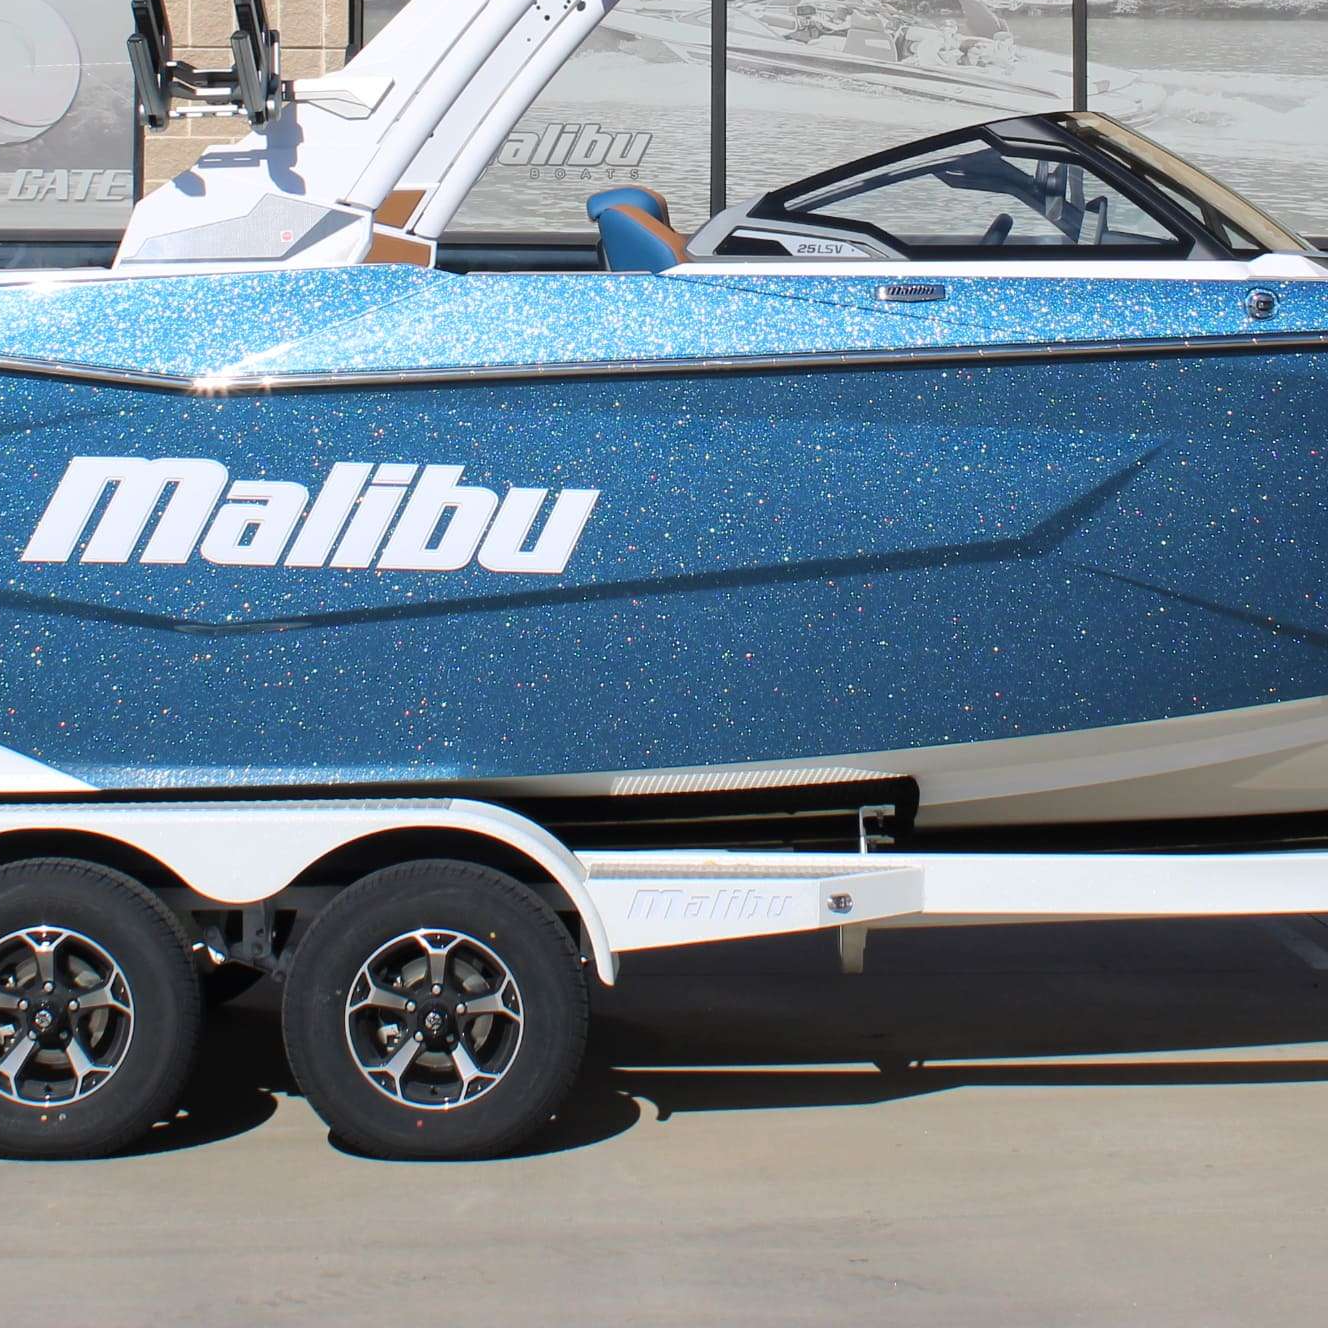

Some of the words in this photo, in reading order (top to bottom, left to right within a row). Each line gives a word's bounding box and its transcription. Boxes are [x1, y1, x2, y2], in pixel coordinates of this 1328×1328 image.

[488, 123, 653, 167] alibu
[8, 168, 133, 202] GATE
[529, 168, 639, 180] BOATS
[20, 455, 601, 574] Malibu
[627, 888, 793, 920] Malibu
